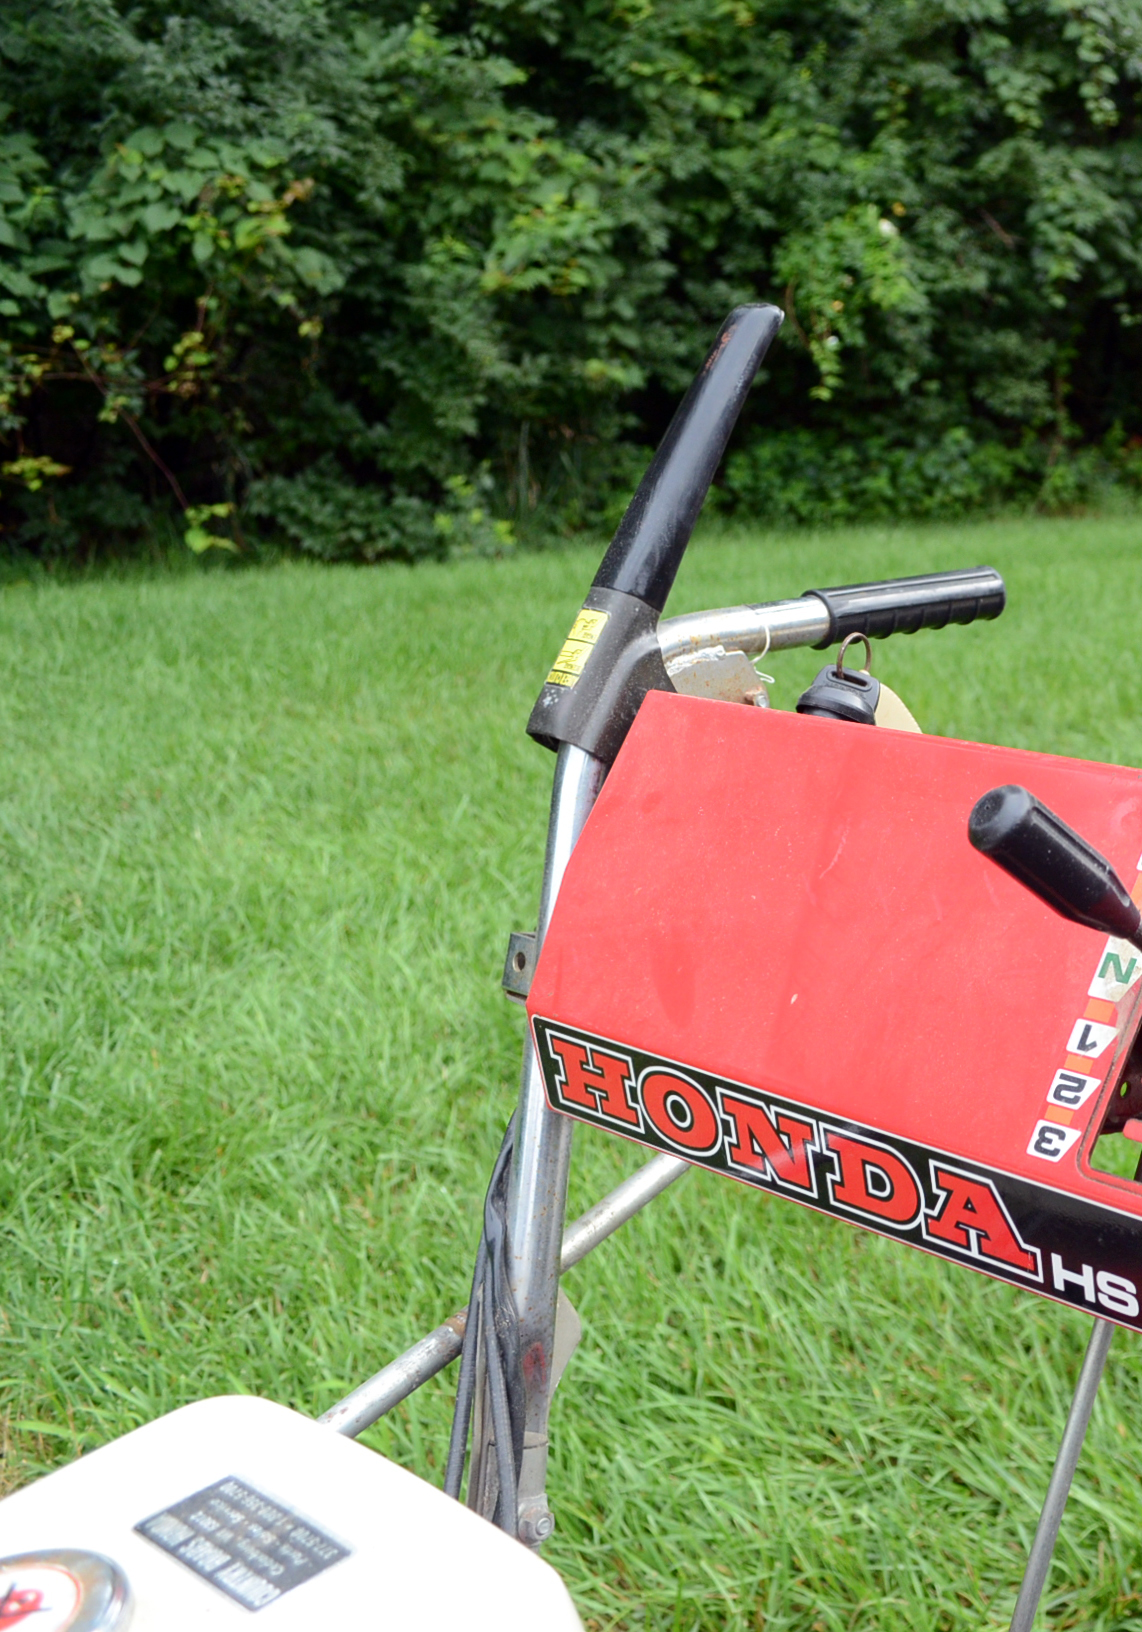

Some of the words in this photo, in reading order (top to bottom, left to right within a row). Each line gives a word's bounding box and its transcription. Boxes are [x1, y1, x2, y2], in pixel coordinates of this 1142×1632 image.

[1098, 952, 1137, 984] N
[1077, 1024, 1098, 1051] 1
[1053, 1073, 1088, 1105] 2
[545, 1029, 1042, 1282] HONDA
[1034, 1125, 1067, 1157] 3
